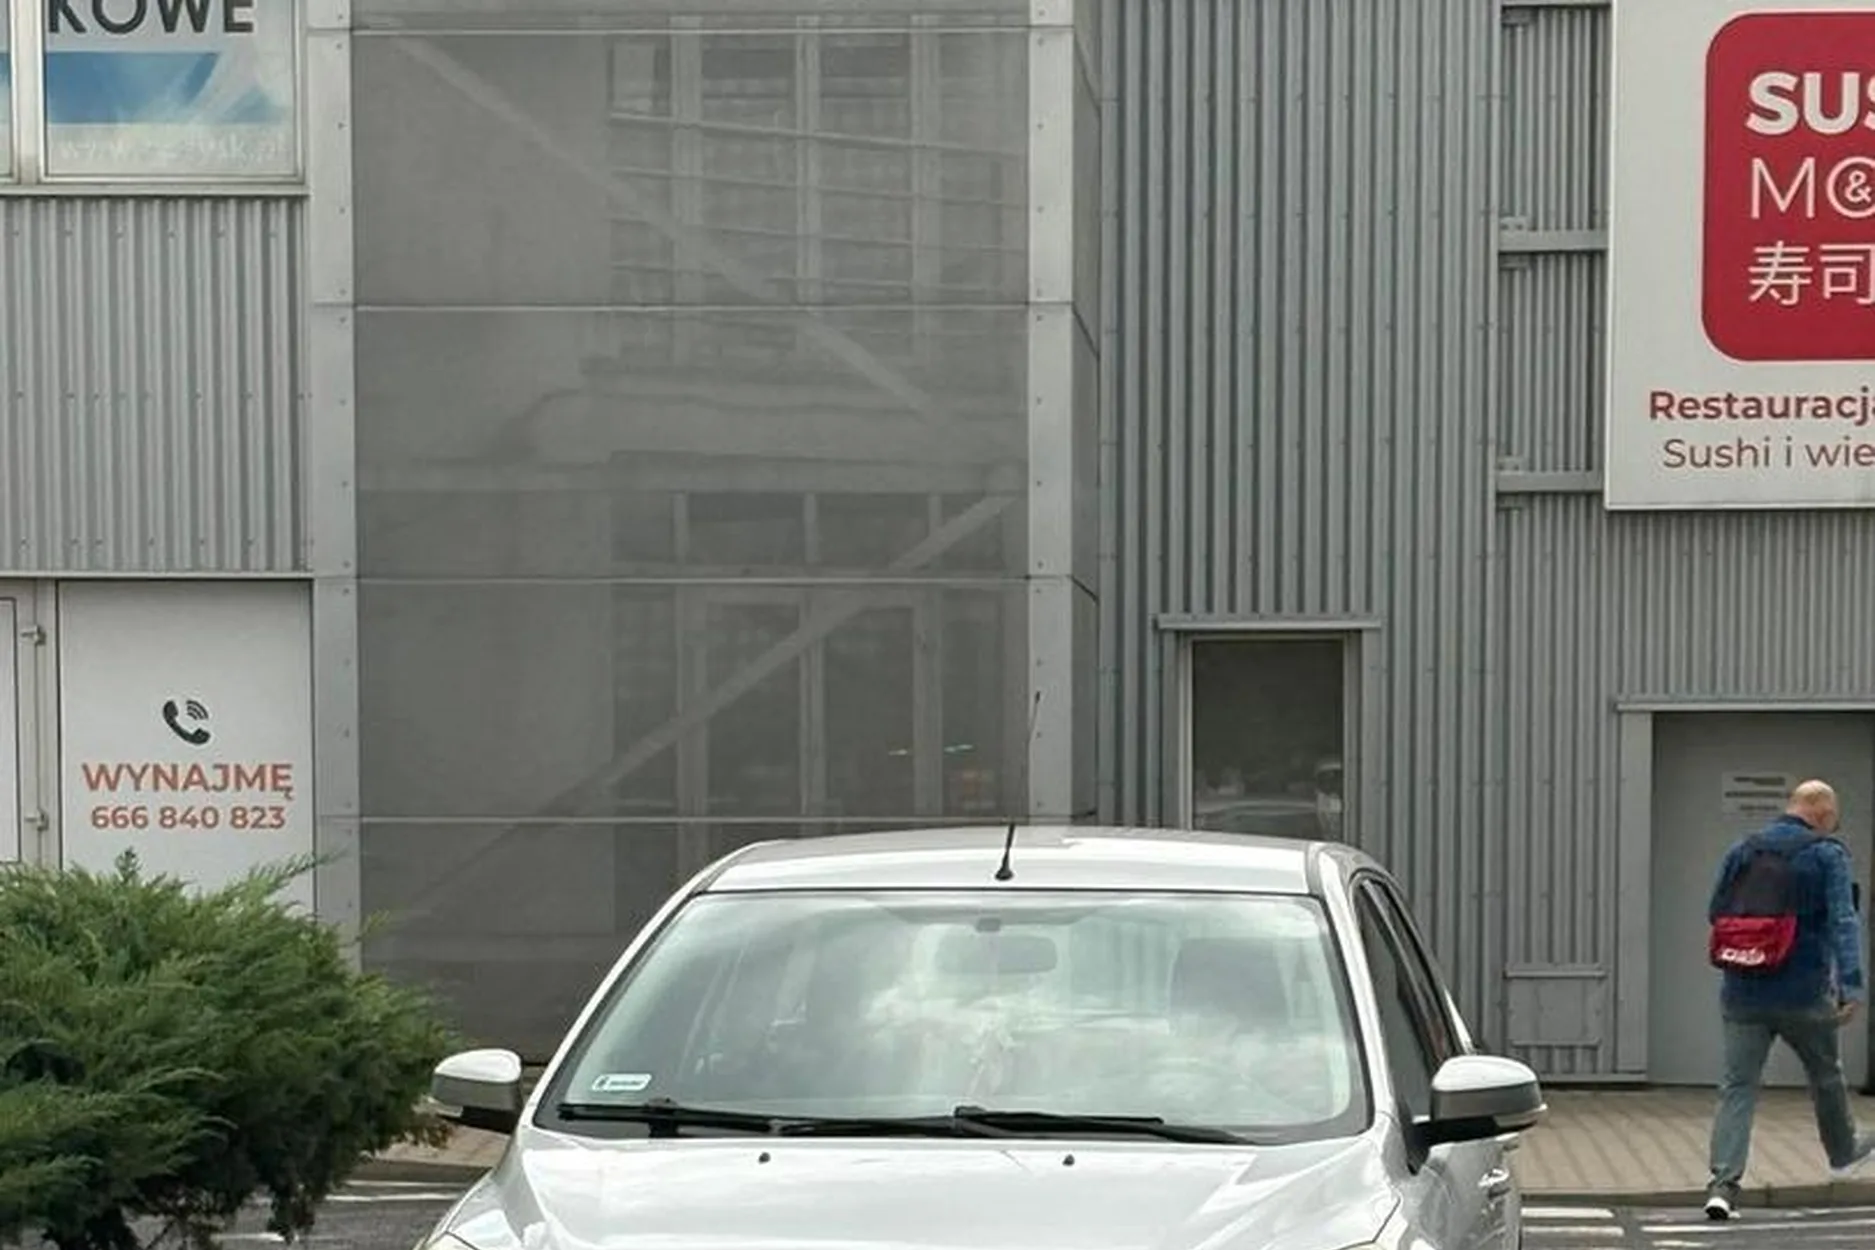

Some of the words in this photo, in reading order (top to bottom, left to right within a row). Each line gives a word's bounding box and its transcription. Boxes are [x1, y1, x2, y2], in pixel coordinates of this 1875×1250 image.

[1745, 71, 1875, 136] SU
[1650, 386, 1875, 426] Restauracj
[1663, 436, 1771, 468] Sushi
[1785, 436, 1792, 468] i
[1804, 436, 1875, 468] wie
[82, 763, 294, 800] WYNAJMĘ
[91, 806, 149, 829] 666
[159, 806, 219, 829] 840
[229, 806, 286, 829] 823
